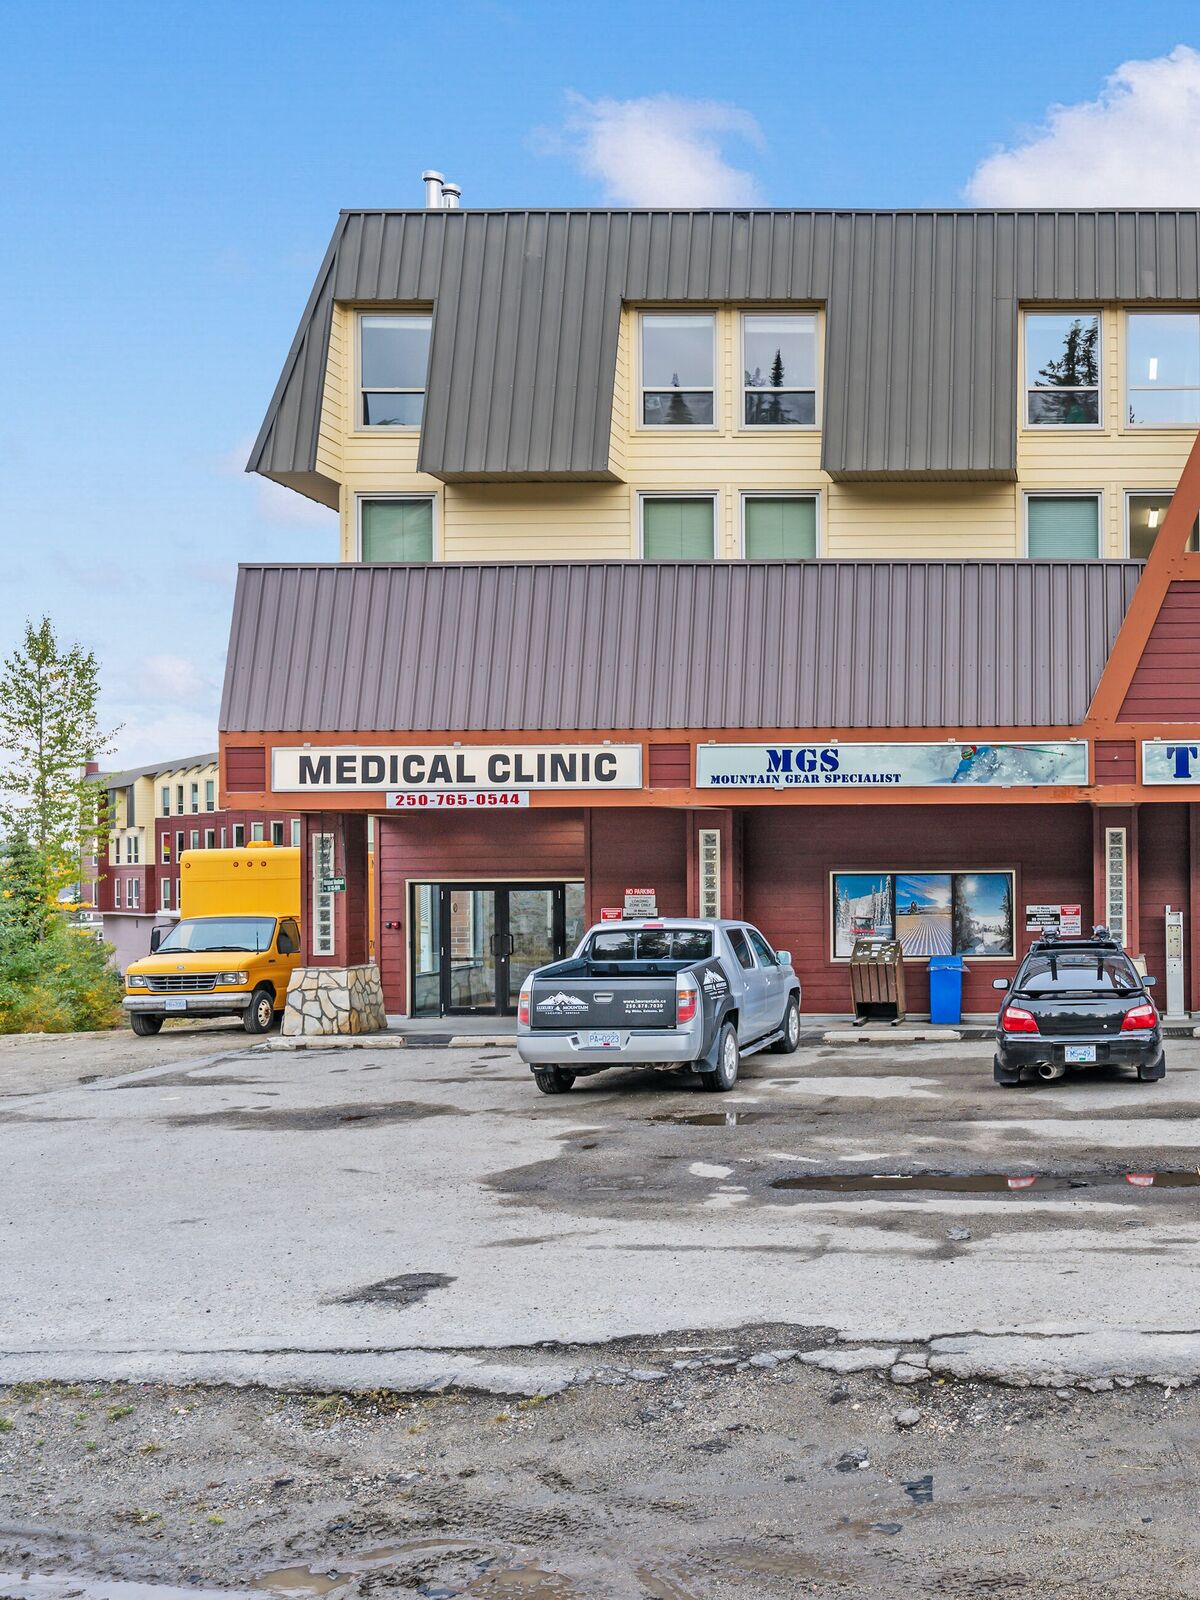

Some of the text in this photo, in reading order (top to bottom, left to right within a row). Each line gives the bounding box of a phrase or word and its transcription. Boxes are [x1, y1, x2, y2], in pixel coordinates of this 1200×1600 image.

[299, 752, 617, 784] MEDICAL CLINIC
[766, 748, 840, 773] MGS
[710, 773, 901, 784] MOUNTAIN GEAR SPECIALIST
[395, 793, 520, 807] 250-765-0544
